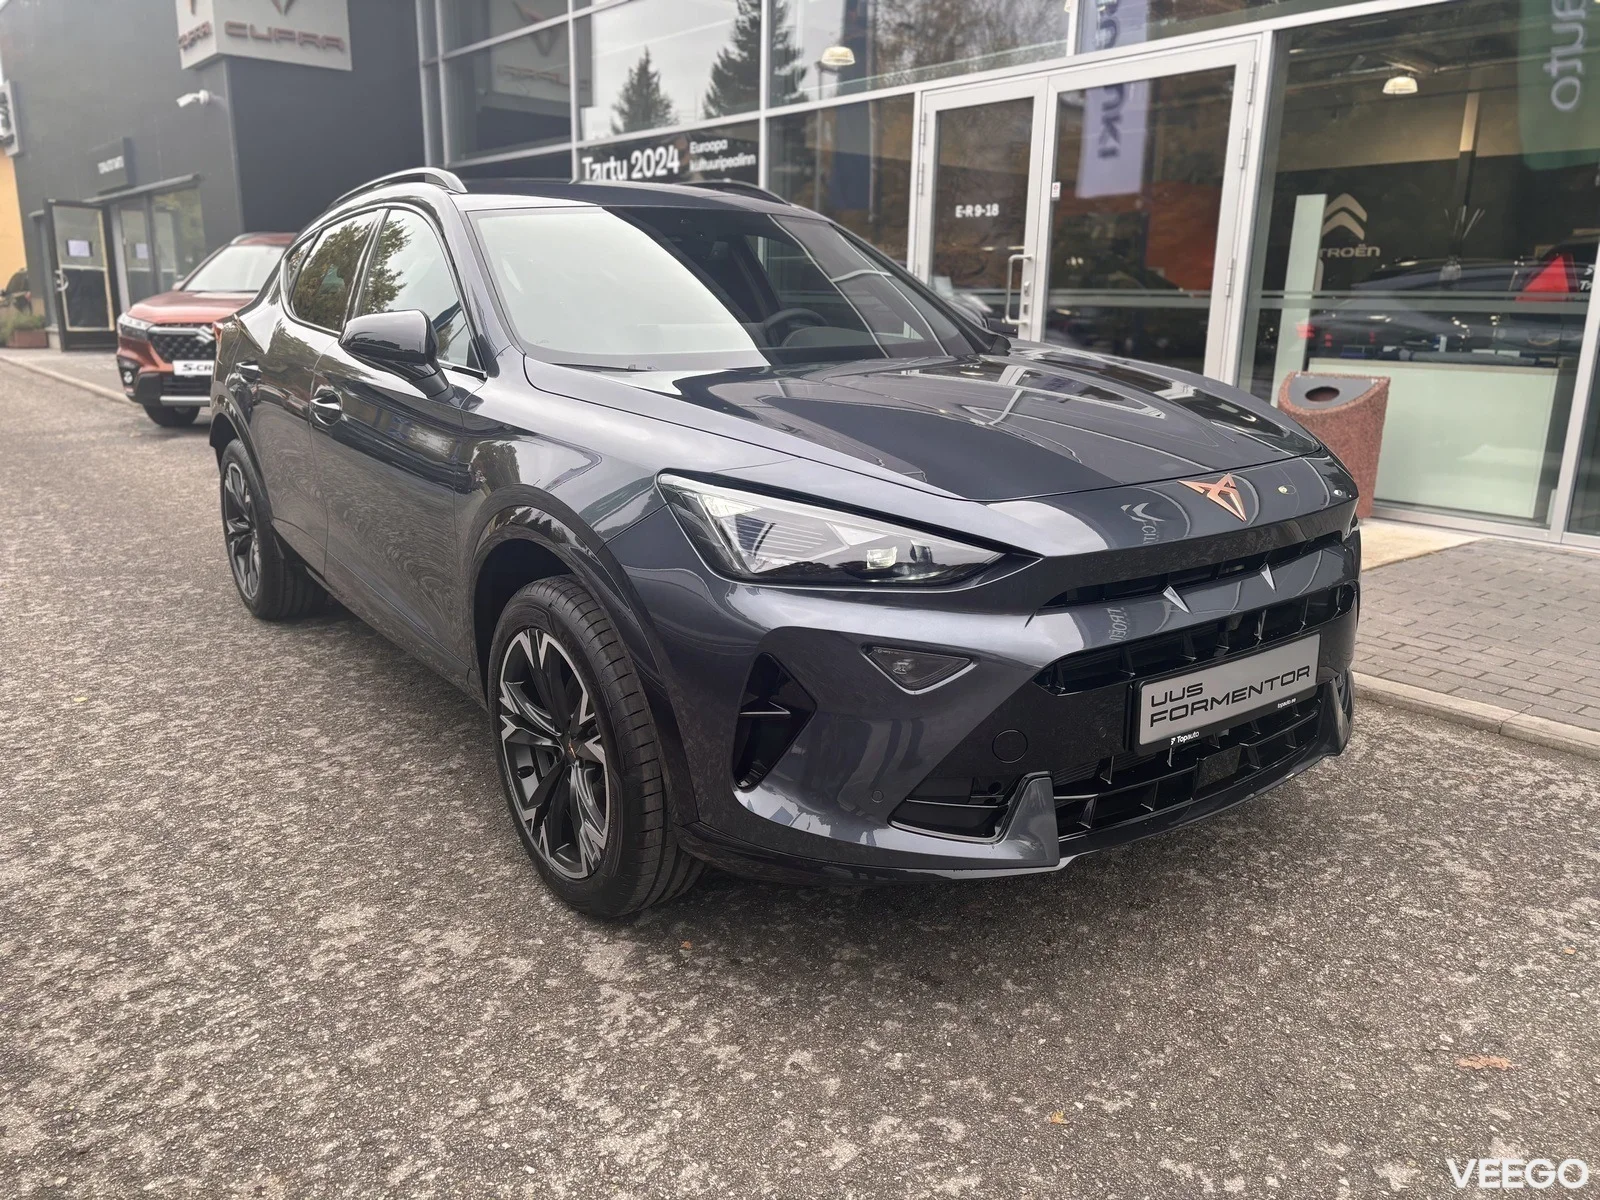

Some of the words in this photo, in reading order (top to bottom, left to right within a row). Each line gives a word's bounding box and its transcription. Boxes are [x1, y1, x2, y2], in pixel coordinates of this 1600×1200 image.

[225, 21, 345, 52] CUPRA
[689, 139, 728, 154] Euroopa
[582, 156, 628, 181] Tartu
[631, 144, 681, 180] 2024
[955, 204, 974, 218] E-R
[974, 203, 1000, 217] 9-18
[1150, 665, 1310, 728] FORMENTOR
[1151, 682, 1203, 708] UUS
[1177, 731, 1200, 744] Topauto
